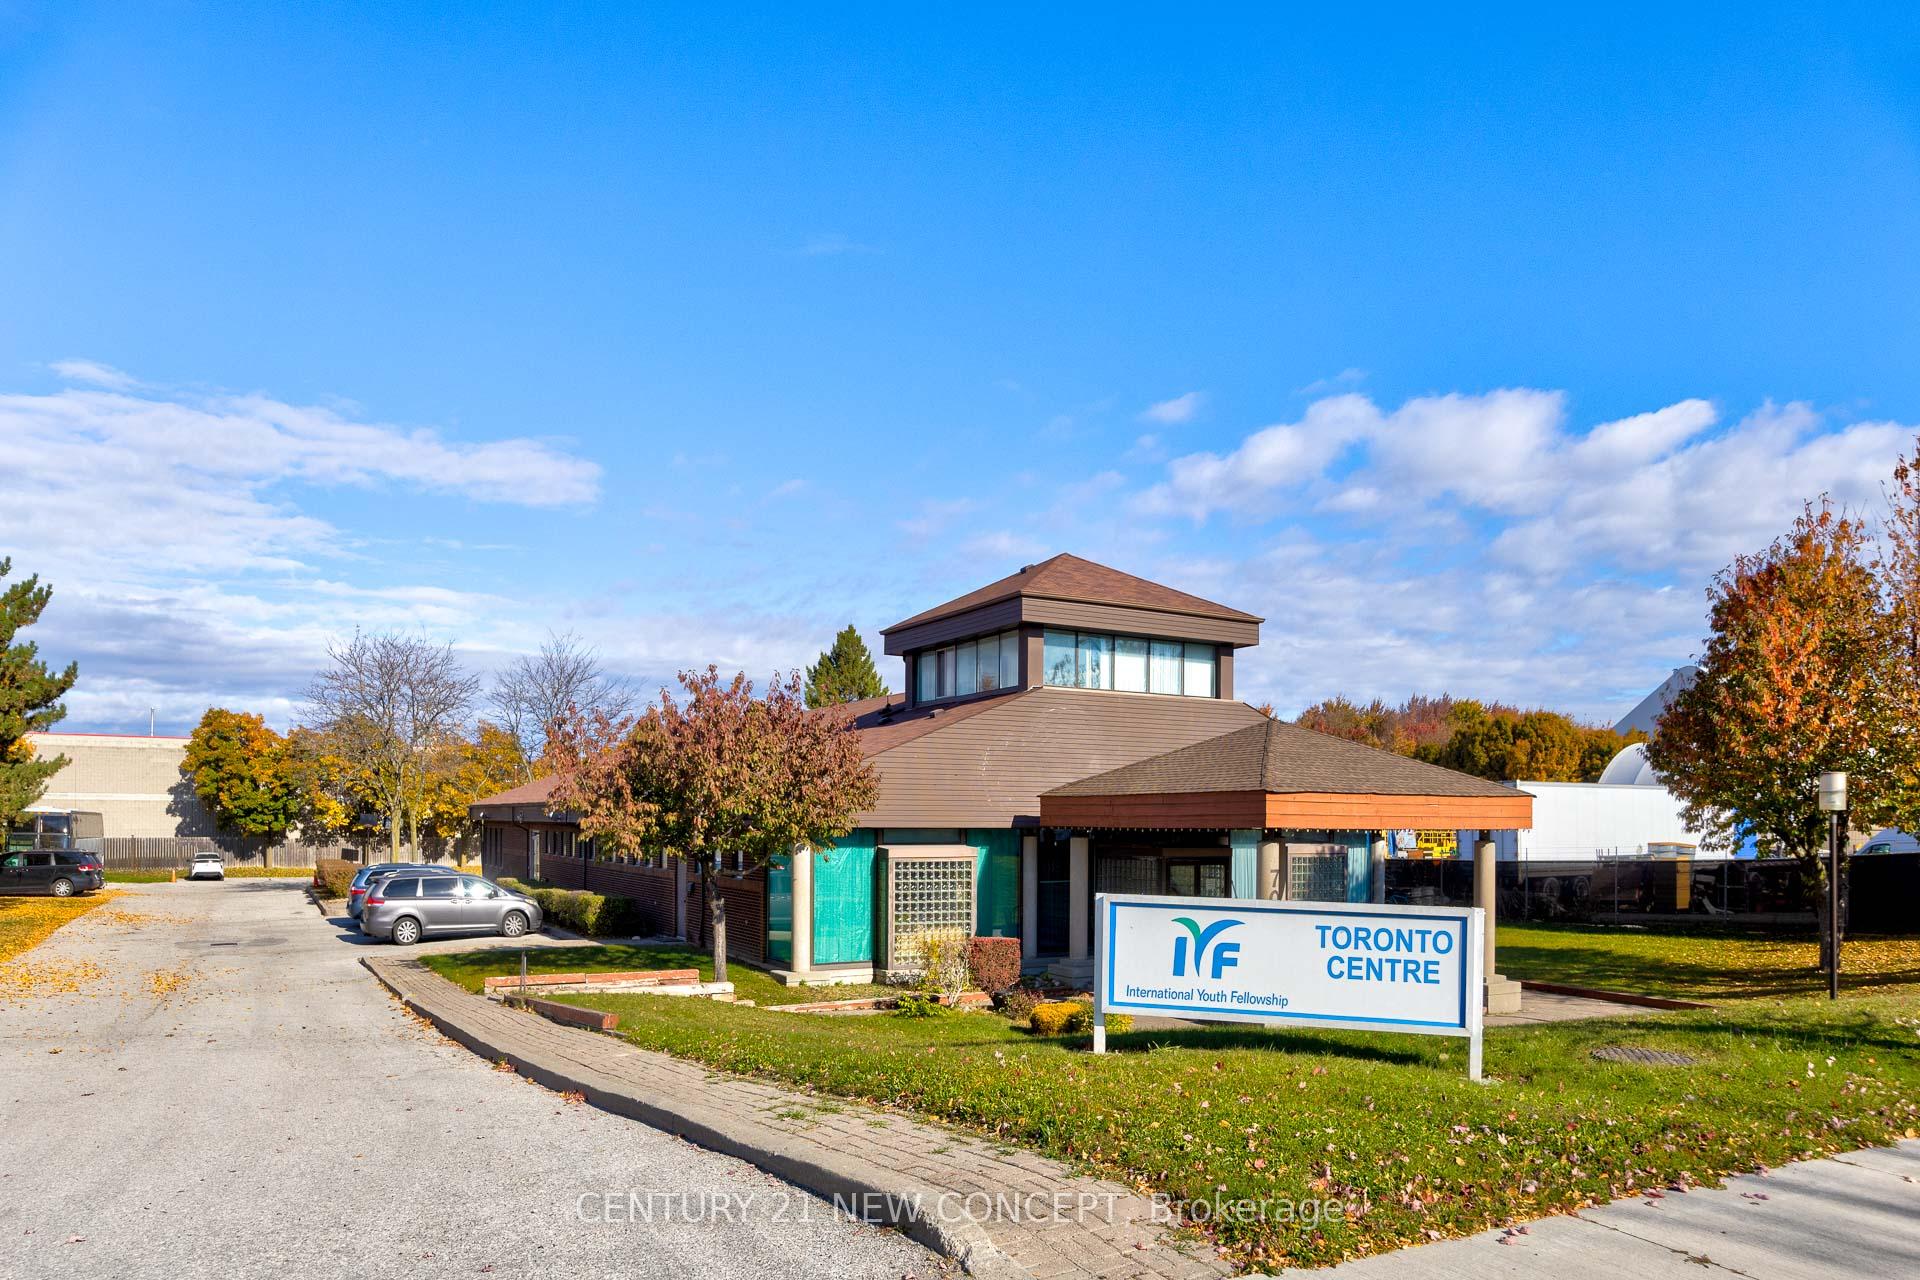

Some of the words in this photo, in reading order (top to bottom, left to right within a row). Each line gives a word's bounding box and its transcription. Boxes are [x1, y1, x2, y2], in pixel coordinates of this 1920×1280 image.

[1171, 917, 1245, 979] IYF
[1315, 925, 1453, 954] TORONTO
[1326, 955, 1440, 984] CENTRE
[1126, 985, 1194, 1001] International
[1197, 989, 1227, 1003] Youth
[1230, 991, 1289, 1009] Fellowship
